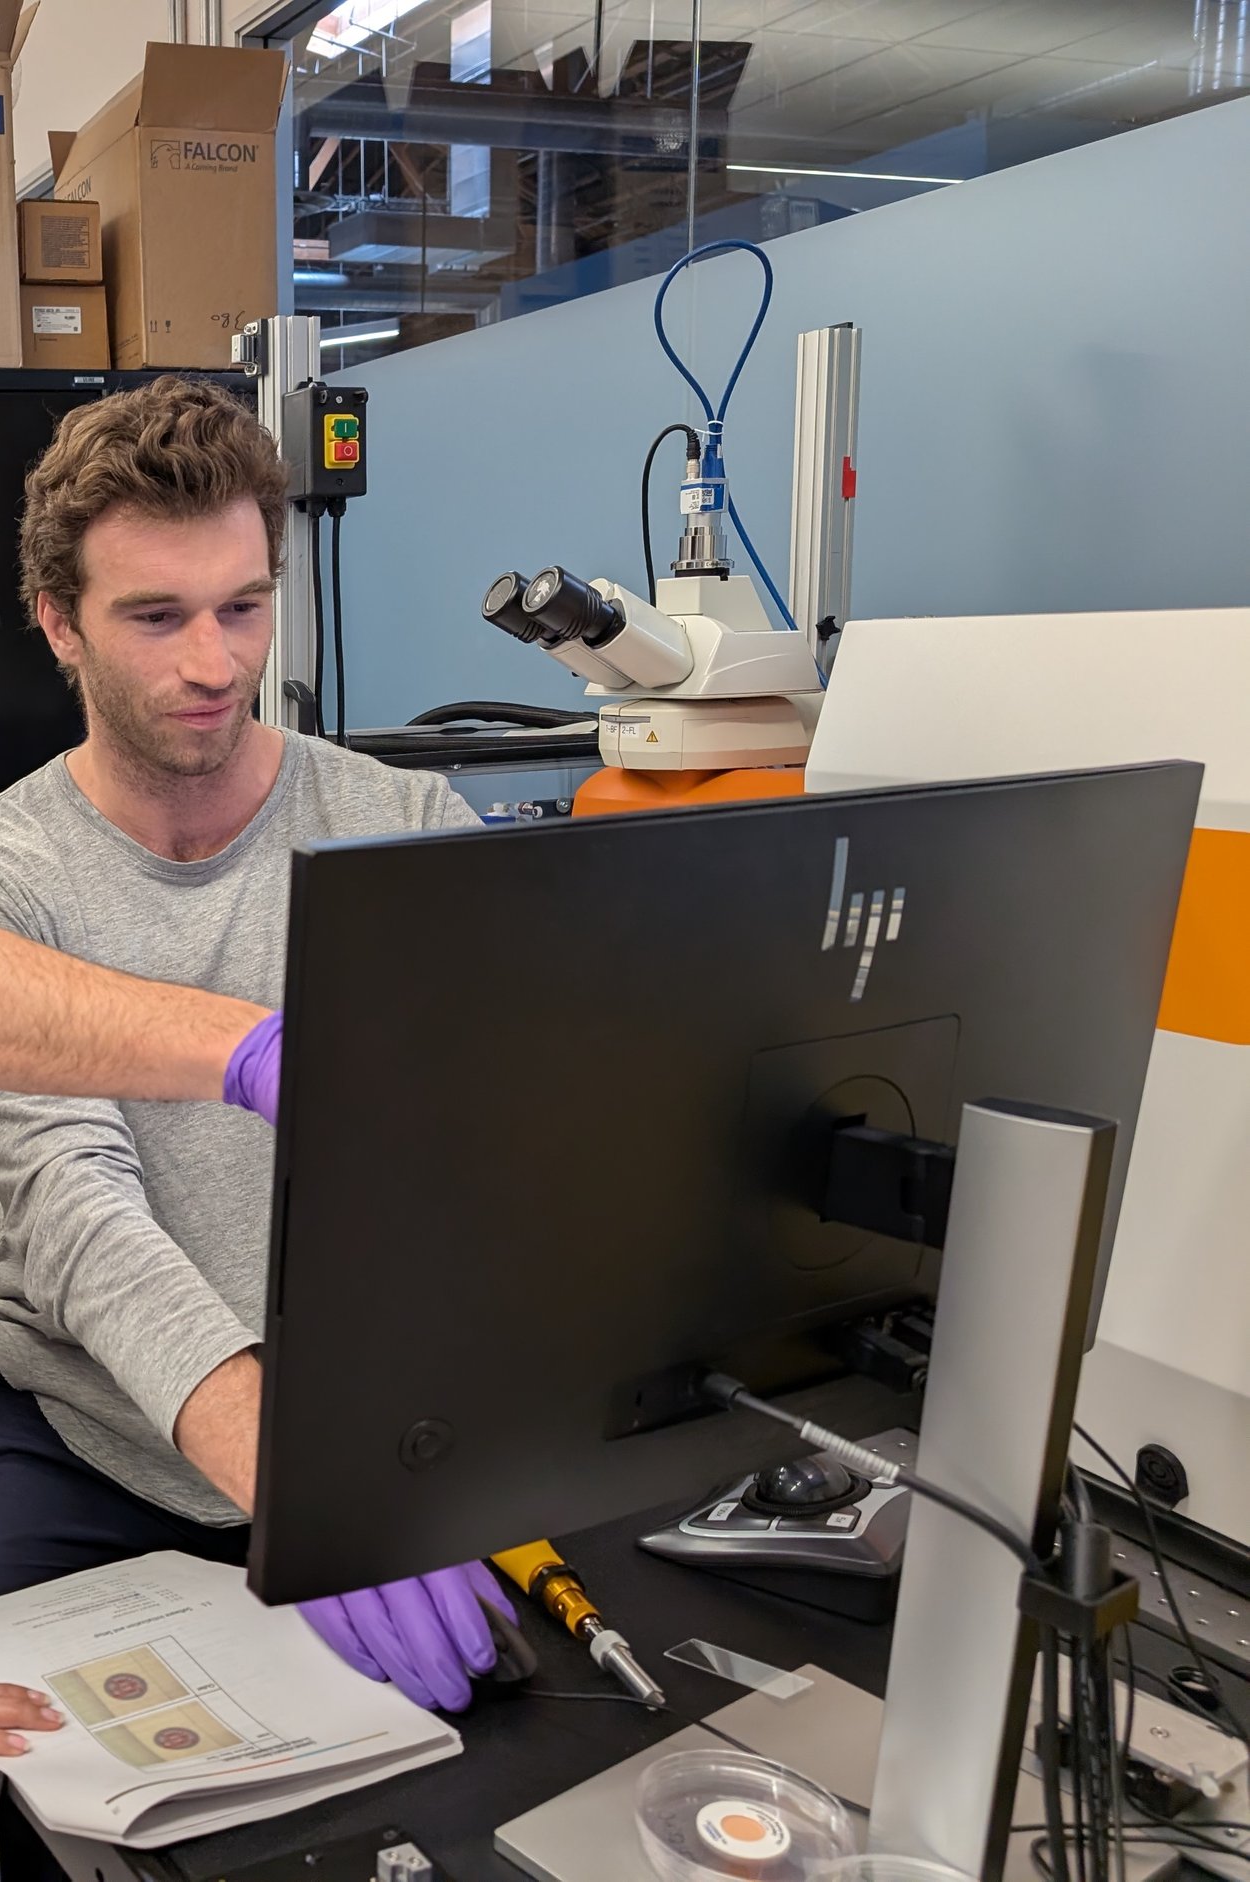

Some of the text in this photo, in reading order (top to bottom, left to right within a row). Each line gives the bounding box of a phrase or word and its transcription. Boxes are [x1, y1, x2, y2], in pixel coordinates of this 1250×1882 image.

[183, 141, 256, 163] FALCON
[191, 163, 217, 174] Corning
[218, 164, 238, 173] Brand
[621, 725, 636, 735] 2-FL
